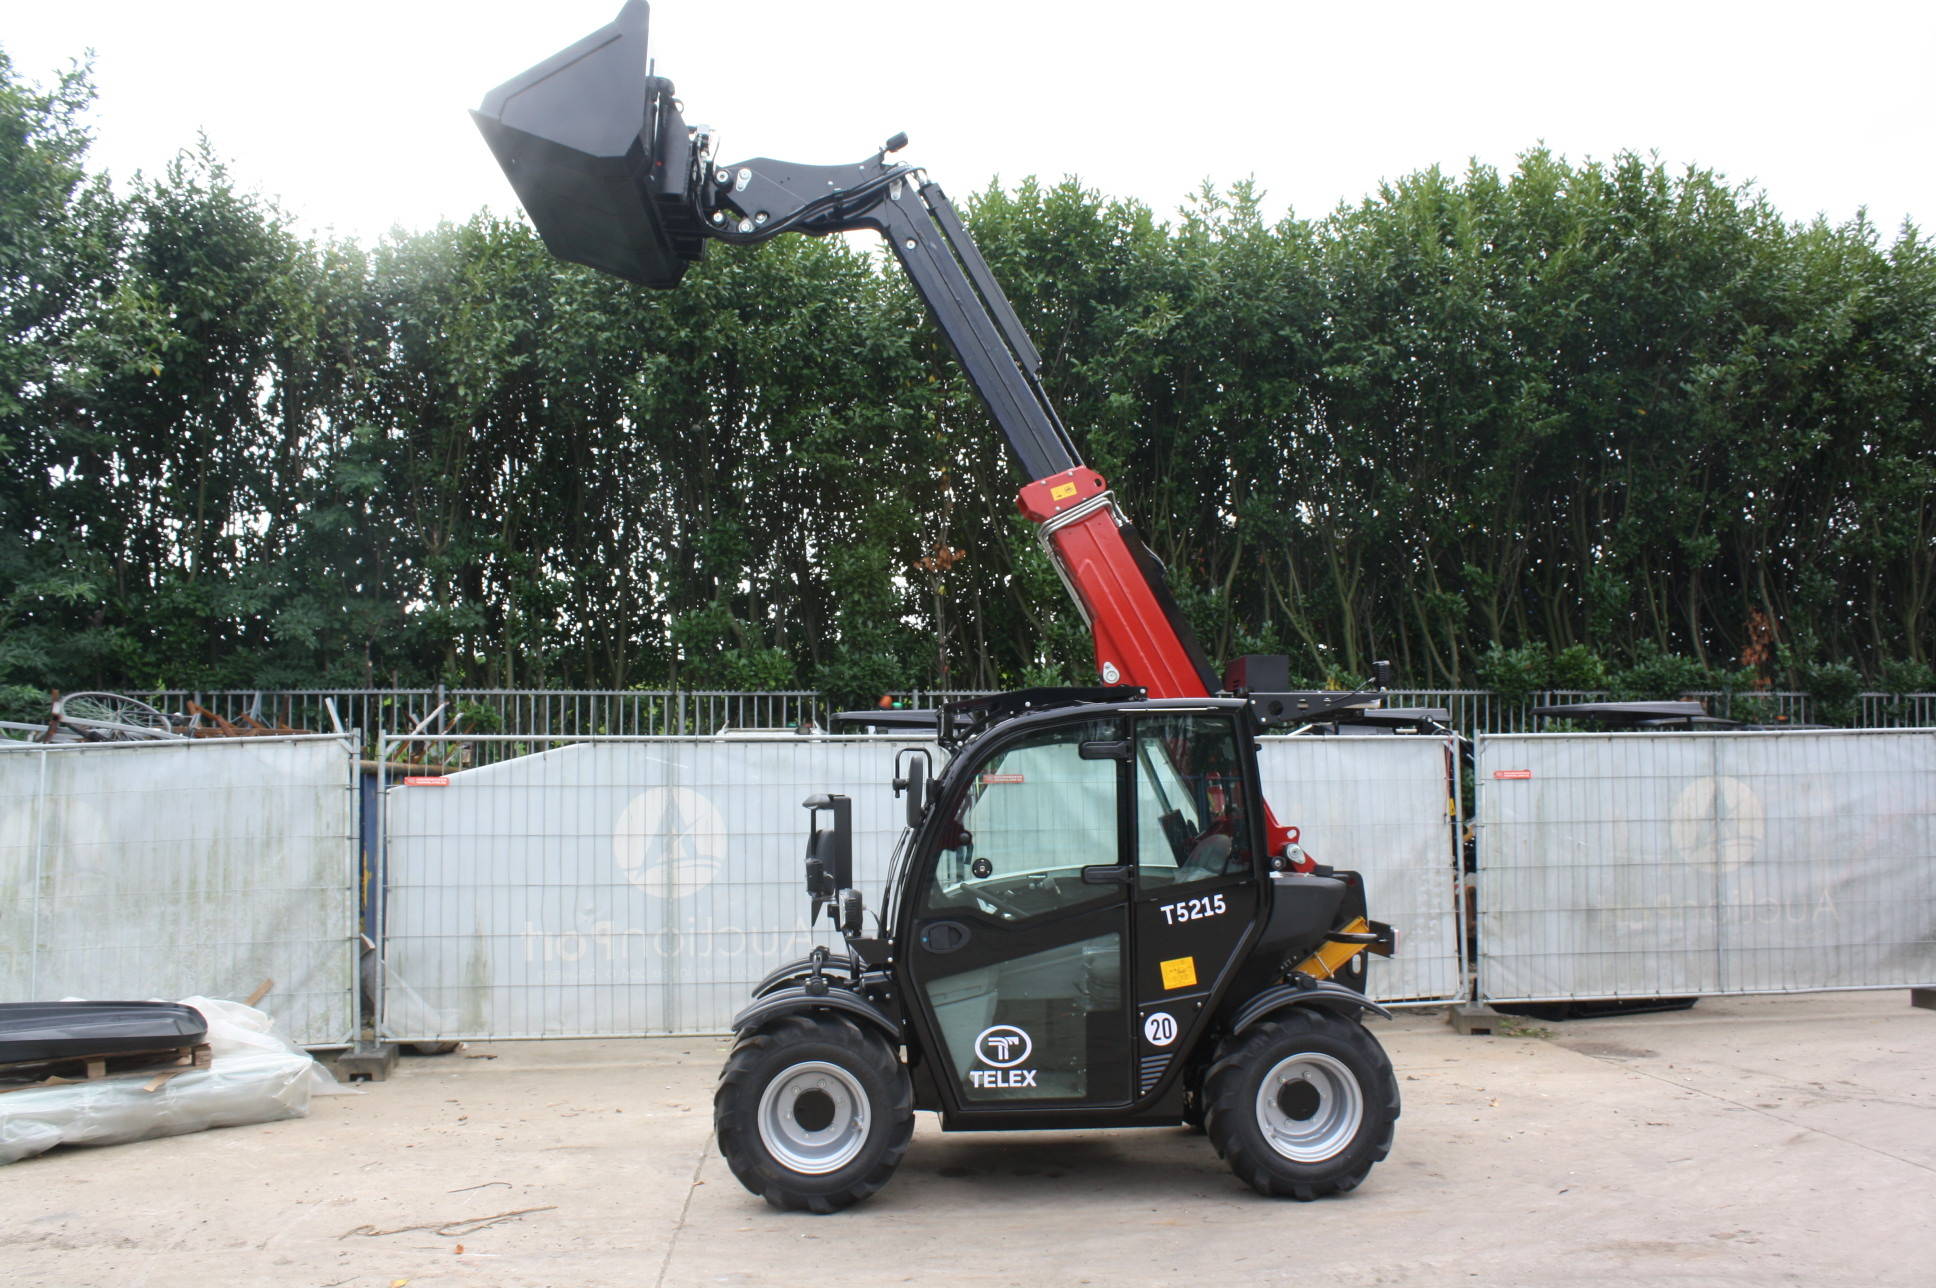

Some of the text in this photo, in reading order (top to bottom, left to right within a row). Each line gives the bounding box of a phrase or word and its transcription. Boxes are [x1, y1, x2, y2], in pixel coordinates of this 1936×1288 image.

[1160, 893, 1227, 925] T5215
[1150, 1017, 1173, 1041] 20
[969, 1070, 1037, 1089] TELEX
